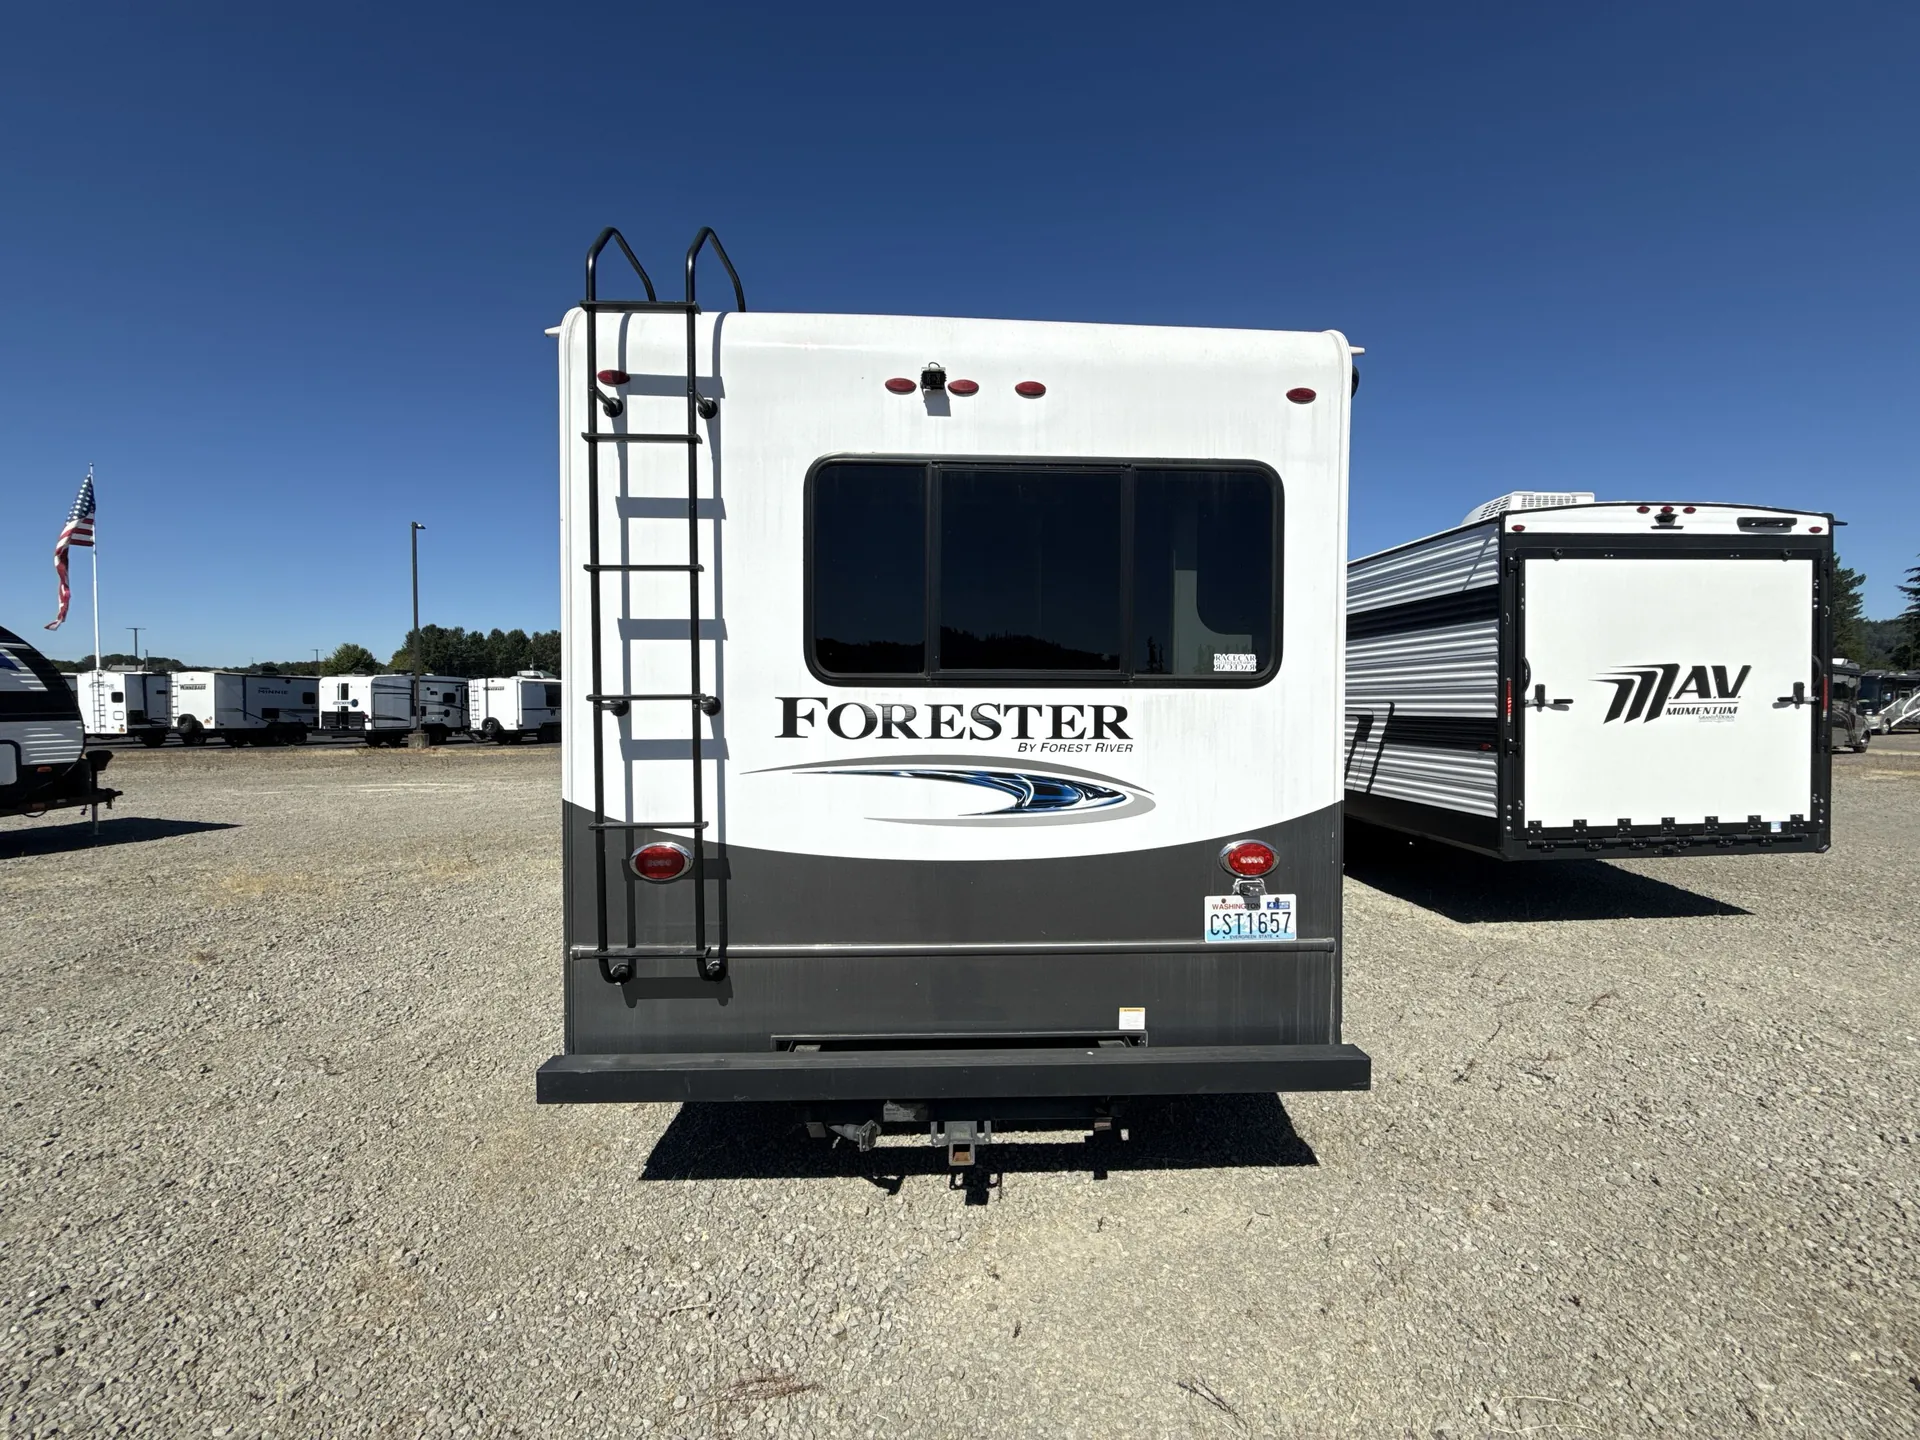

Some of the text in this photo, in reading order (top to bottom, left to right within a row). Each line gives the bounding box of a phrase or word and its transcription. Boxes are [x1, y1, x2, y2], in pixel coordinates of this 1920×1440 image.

[1666, 706, 1738, 715] MOMENTUM
[774, 696, 1133, 741] FORESTER
[1017, 742, 1134, 753] BY FOREST RIVER
[1212, 903, 1261, 911] WASHINGTON
[1210, 911, 1291, 935] CST1657
